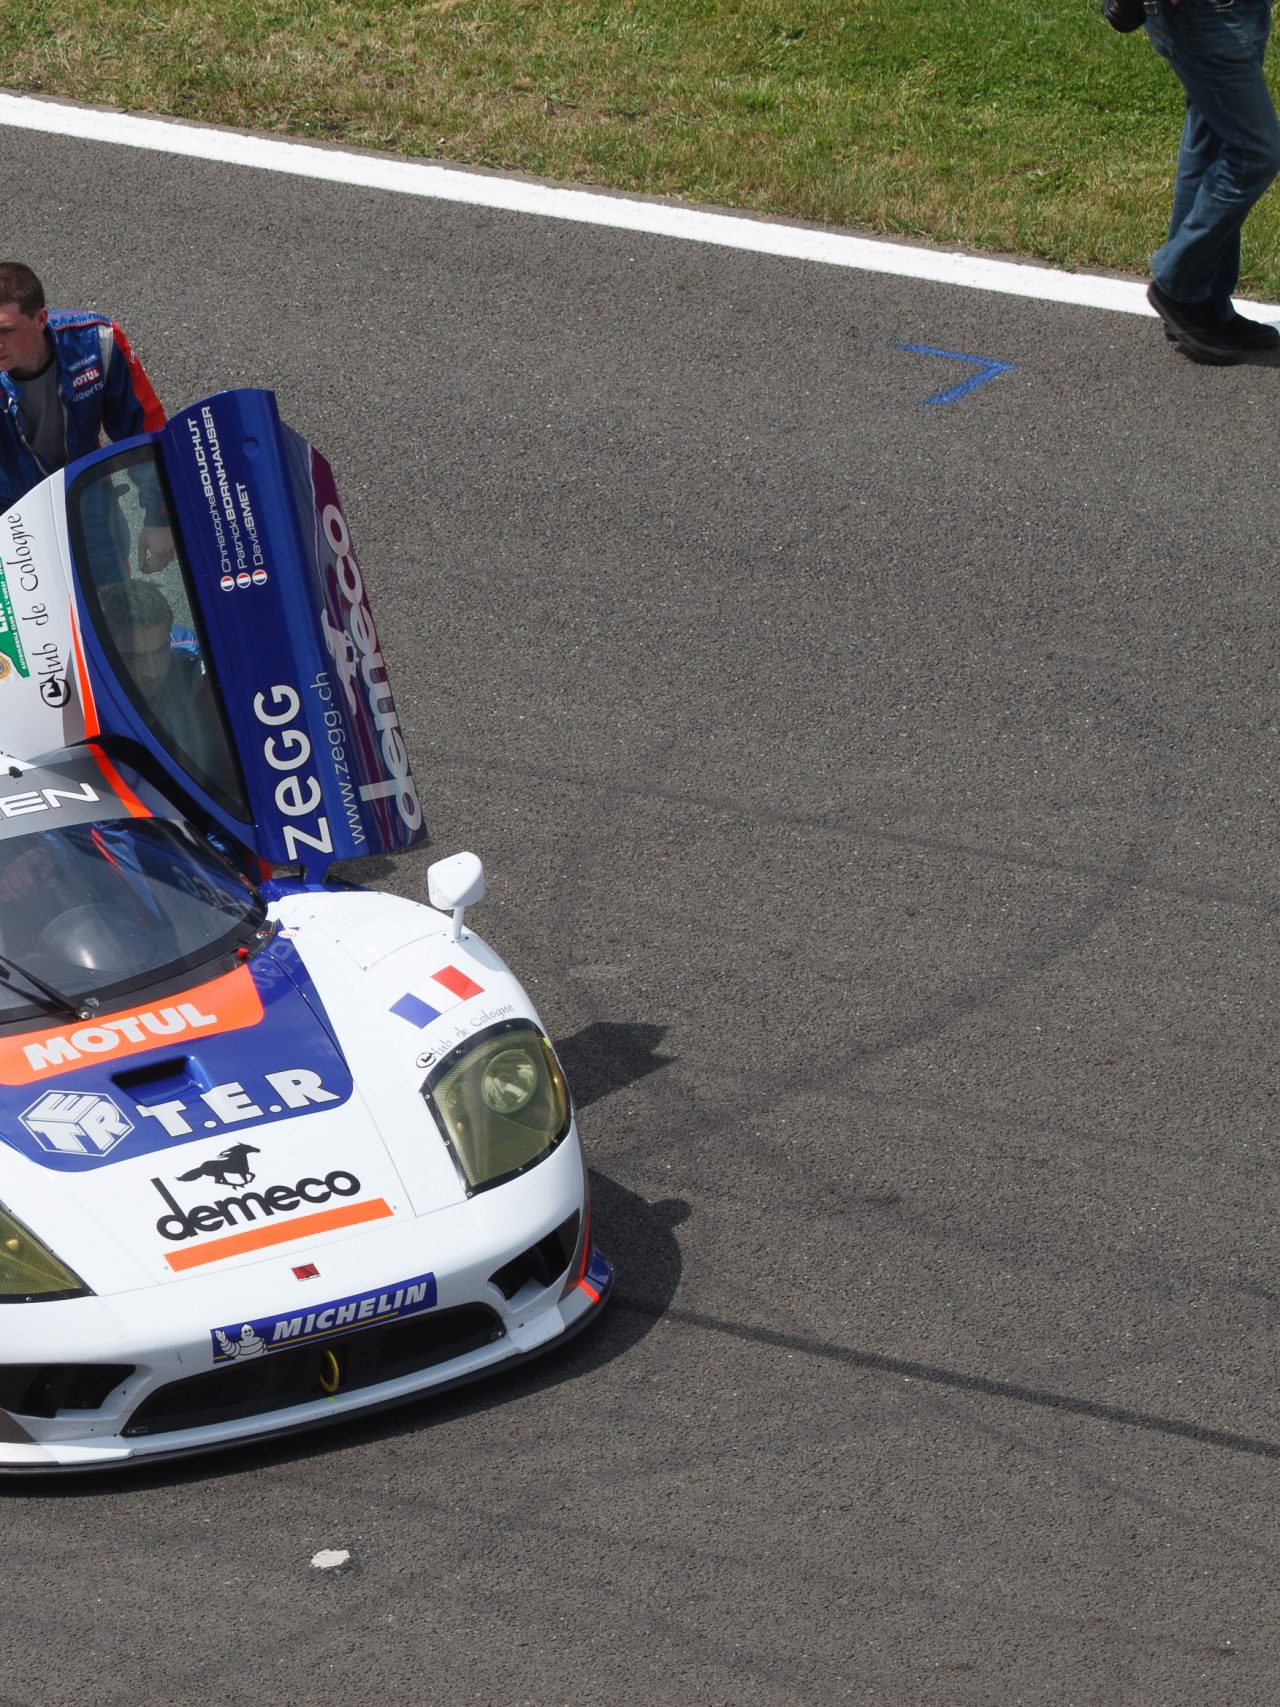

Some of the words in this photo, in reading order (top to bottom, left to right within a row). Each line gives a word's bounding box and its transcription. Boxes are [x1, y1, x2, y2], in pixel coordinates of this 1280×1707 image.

[6, 513, 40, 592] Cologne
[21, 603, 49, 627] de
[322, 504, 421, 831] demeco
[309, 671, 366, 845] www.zegg.ch
[22, 1002, 218, 1071] MOTUL
[454, 1026, 470, 1037] de
[470, 1003, 516, 1027] Cologne
[134, 1068, 341, 1138] T.E.R
[150, 1170, 362, 1241] demeco
[272, 1281, 427, 1341] MICHELIN
